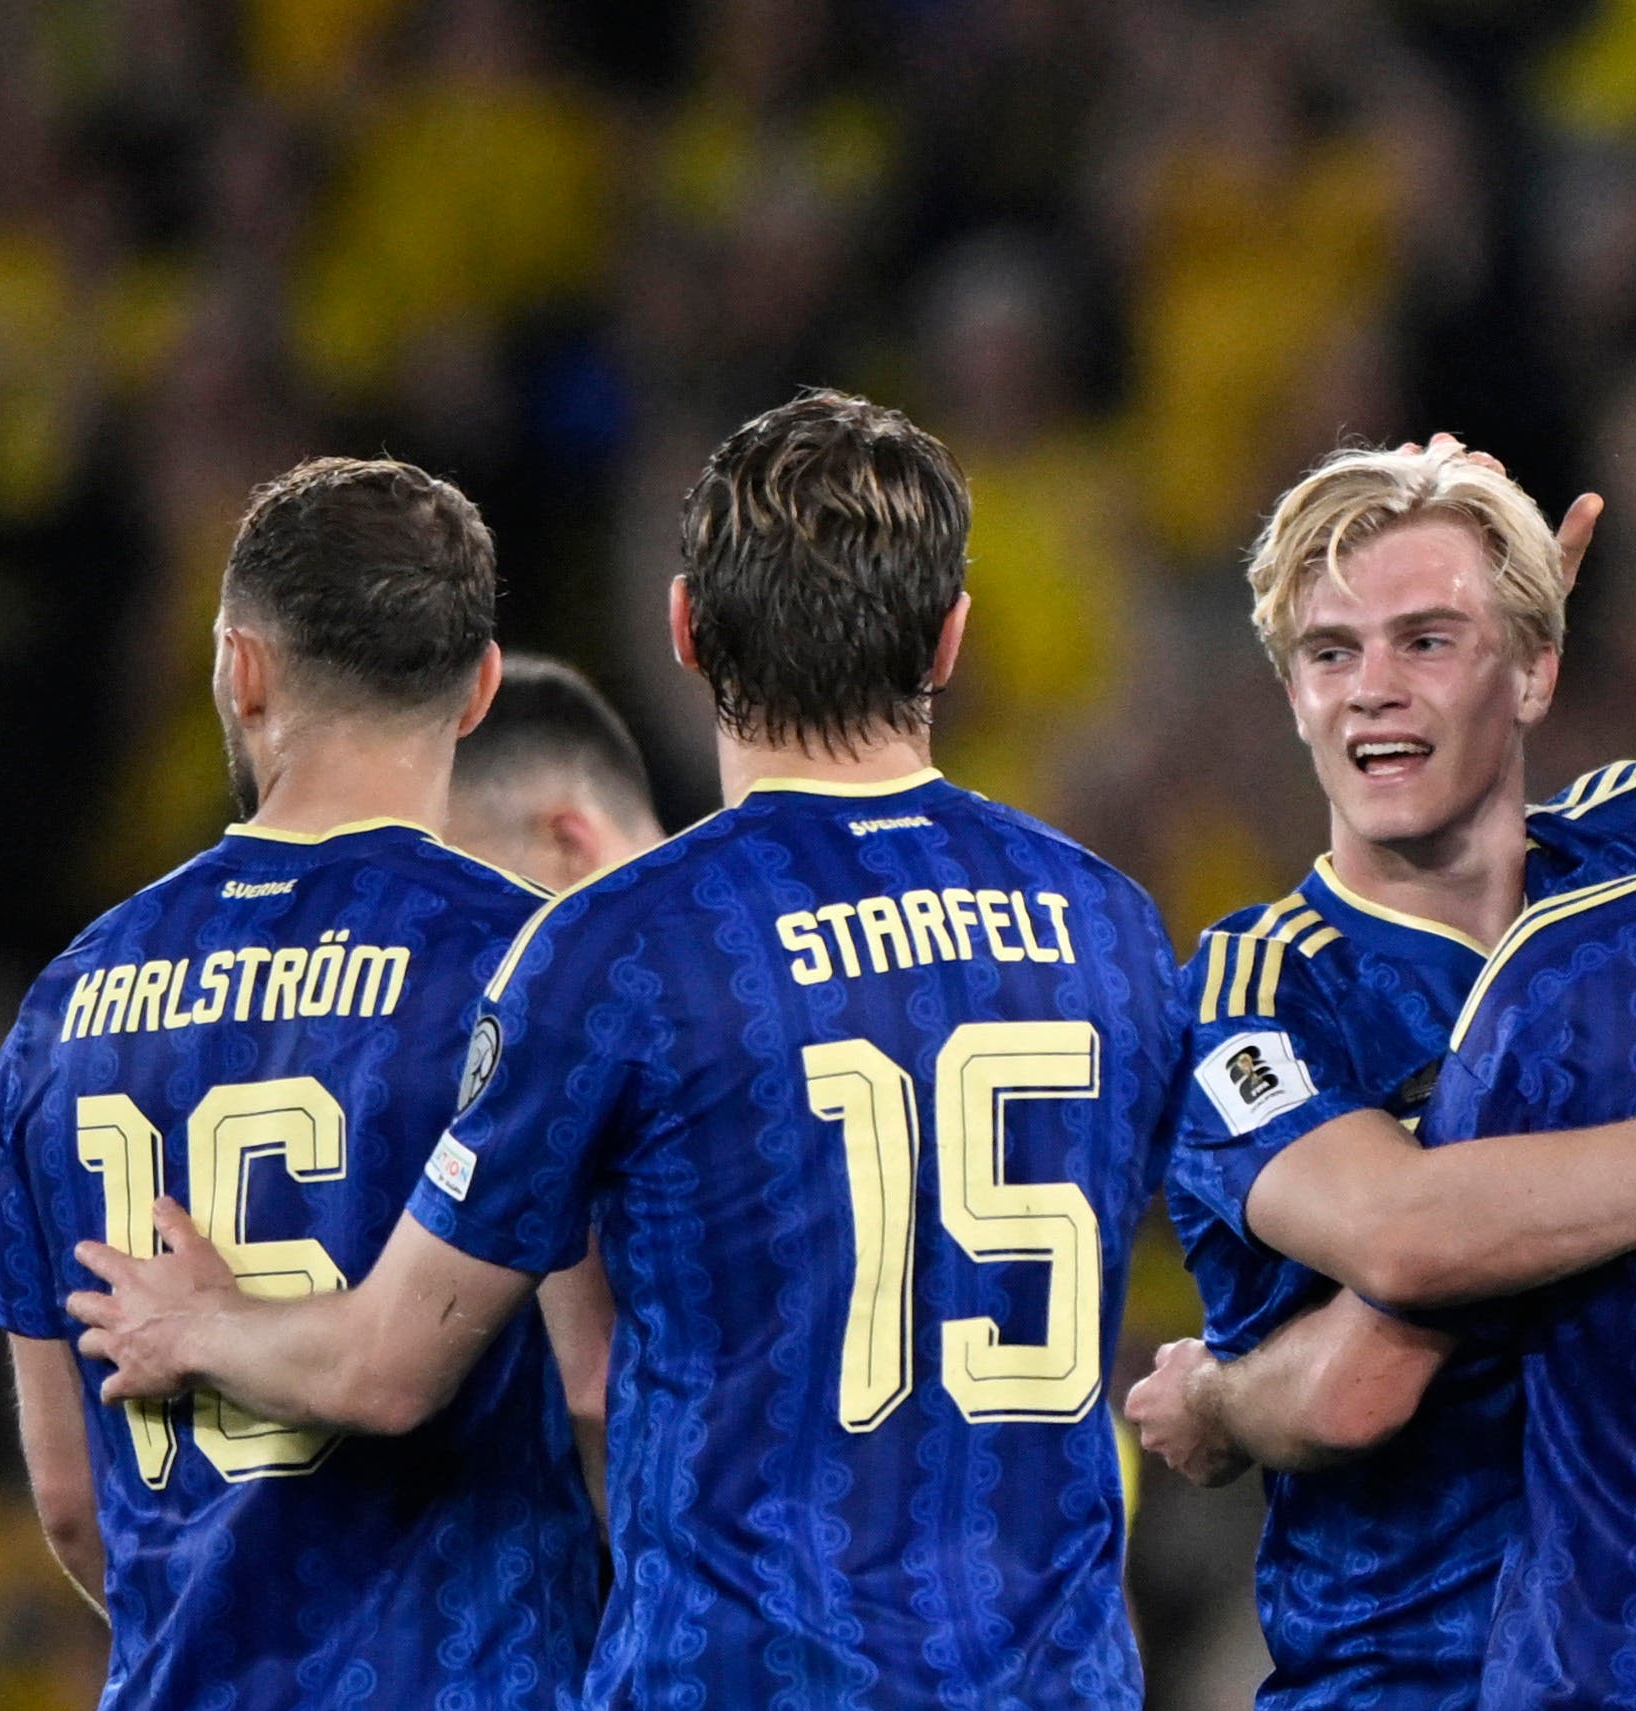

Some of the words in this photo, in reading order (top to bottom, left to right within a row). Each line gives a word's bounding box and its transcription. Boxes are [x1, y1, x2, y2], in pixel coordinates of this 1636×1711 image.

[60, 928, 411, 1043] KARLSTRÖM
[775, 887, 1076, 986] STARFELT
[76, 1075, 347, 1491] 16
[801, 1020, 1102, 1433] 15
